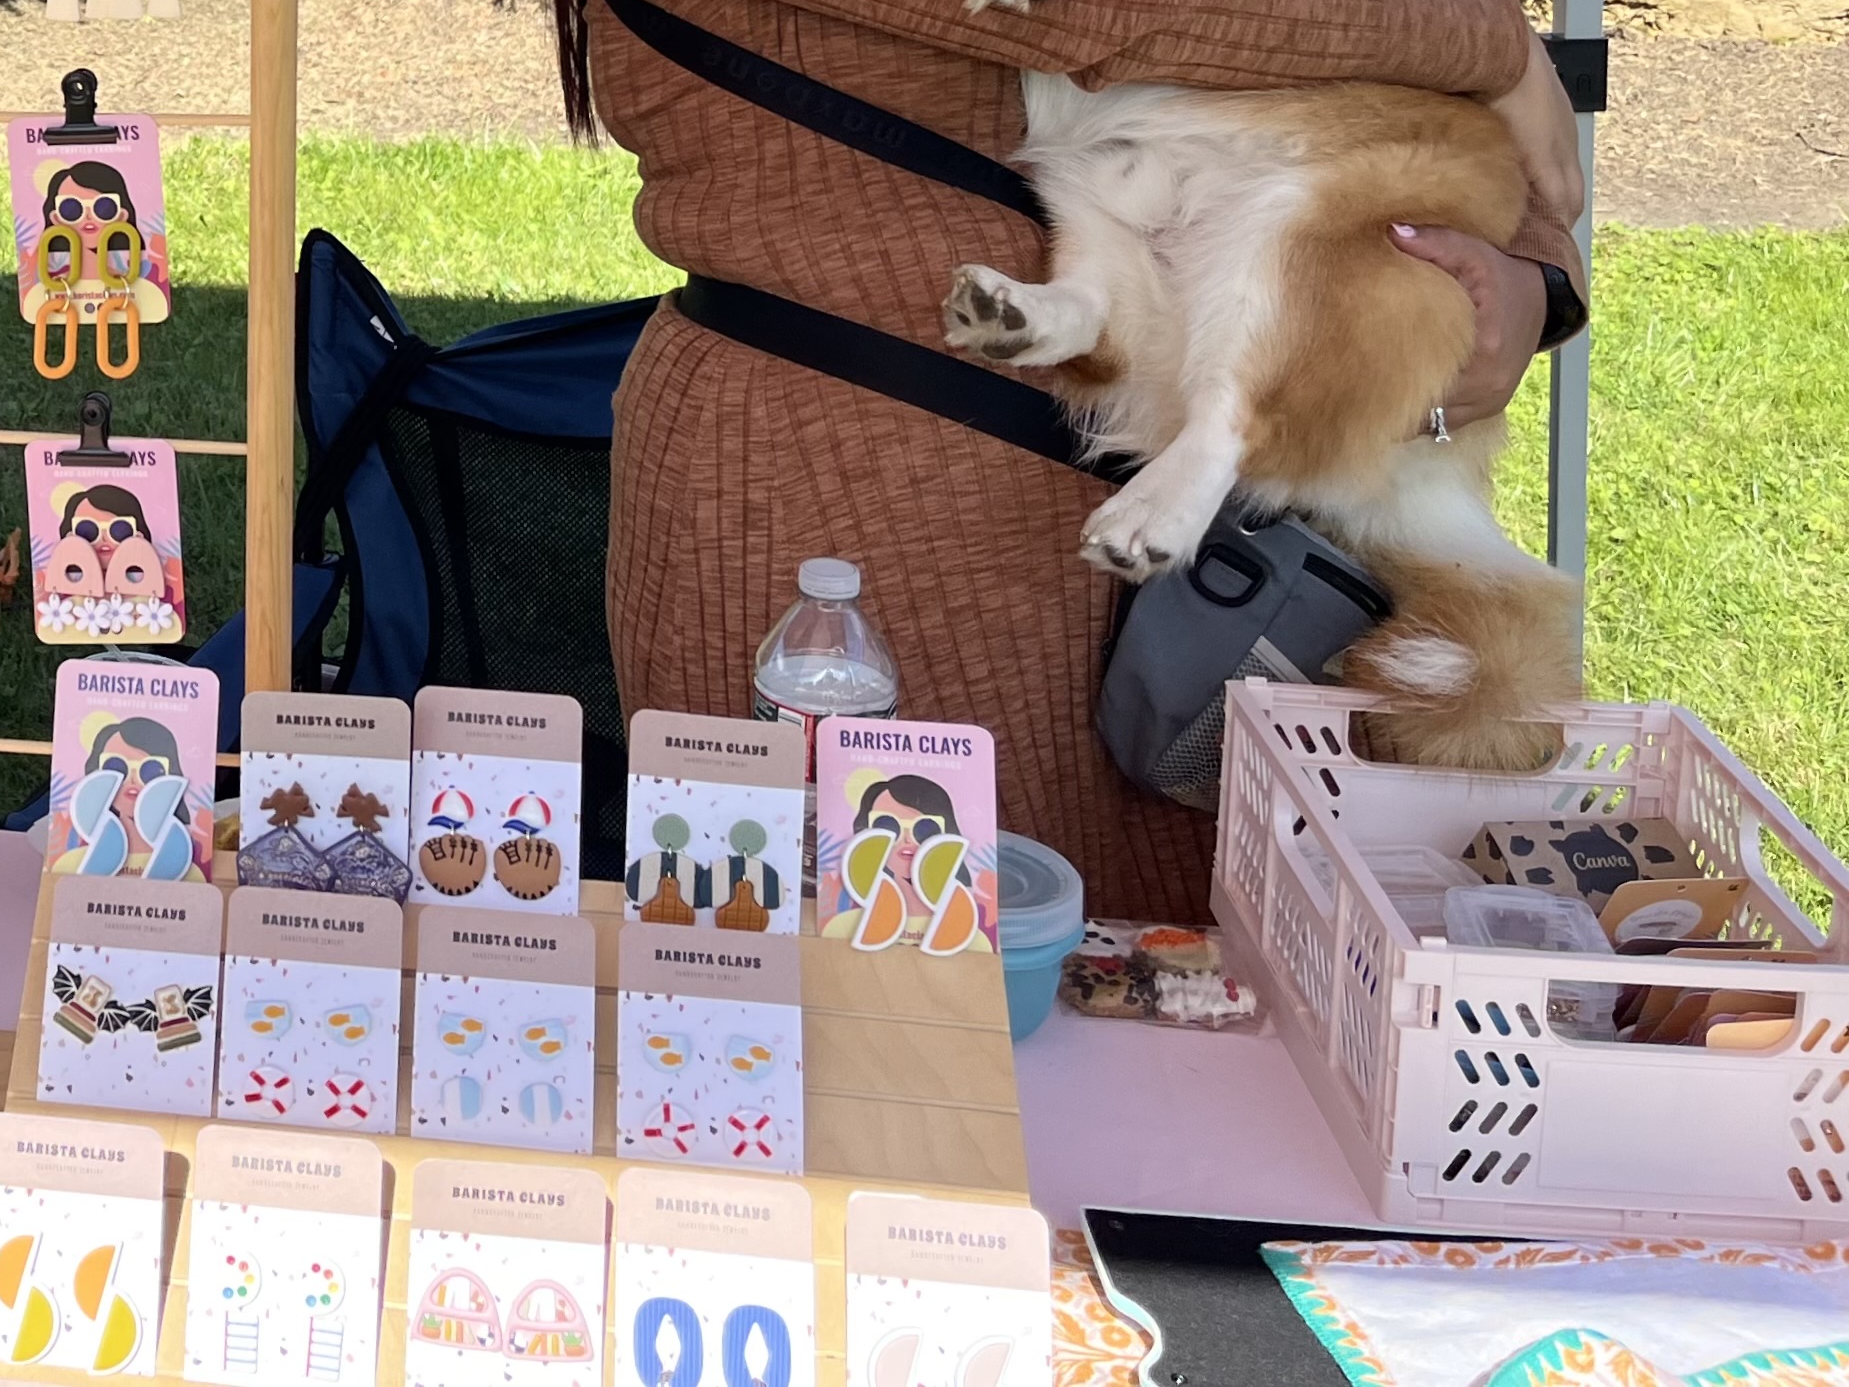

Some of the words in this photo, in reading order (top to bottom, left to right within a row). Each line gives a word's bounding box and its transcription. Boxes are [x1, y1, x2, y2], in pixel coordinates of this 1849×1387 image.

[78, 673, 144, 696] BARISTA
[150, 678, 199, 699] CLAYS
[276, 714, 332, 727] BARISTA
[335, 717, 375, 730] CLAYS
[448, 712, 502, 726] BARISTA
[506, 716, 546, 730] CLAYS
[665, 736, 722, 752] BARISTA
[726, 743, 768, 757] CLAYS
[840, 730, 912, 752] BARISTA
[919, 735, 972, 756] CLAYS
[1573, 852, 1630, 870] Canva
[87, 902, 142, 918] BARISTA
[145, 906, 186, 921] CLAYS
[262, 914, 318, 929] BARISTA
[322, 918, 364, 933] CLAYS
[452, 931, 510, 946] BARISTA
[514, 936, 556, 950] CLAYS
[655, 949, 714, 965] BARISTA
[718, 955, 761, 969] CLAYS
[17, 1141, 77, 1158] BARISTA
[81, 1147, 125, 1162] CLAYS
[232, 1156, 293, 1173] BARISTA
[297, 1162, 342, 1178] CLAYS
[452, 1186, 514, 1203] BARISTA
[519, 1190, 565, 1206] CLAYS
[656, 1197, 720, 1216] BARISTA
[723, 1204, 770, 1222] CLAYS
[888, 1226, 954, 1245] BARISTA
[958, 1232, 1006, 1250] CLAYS
